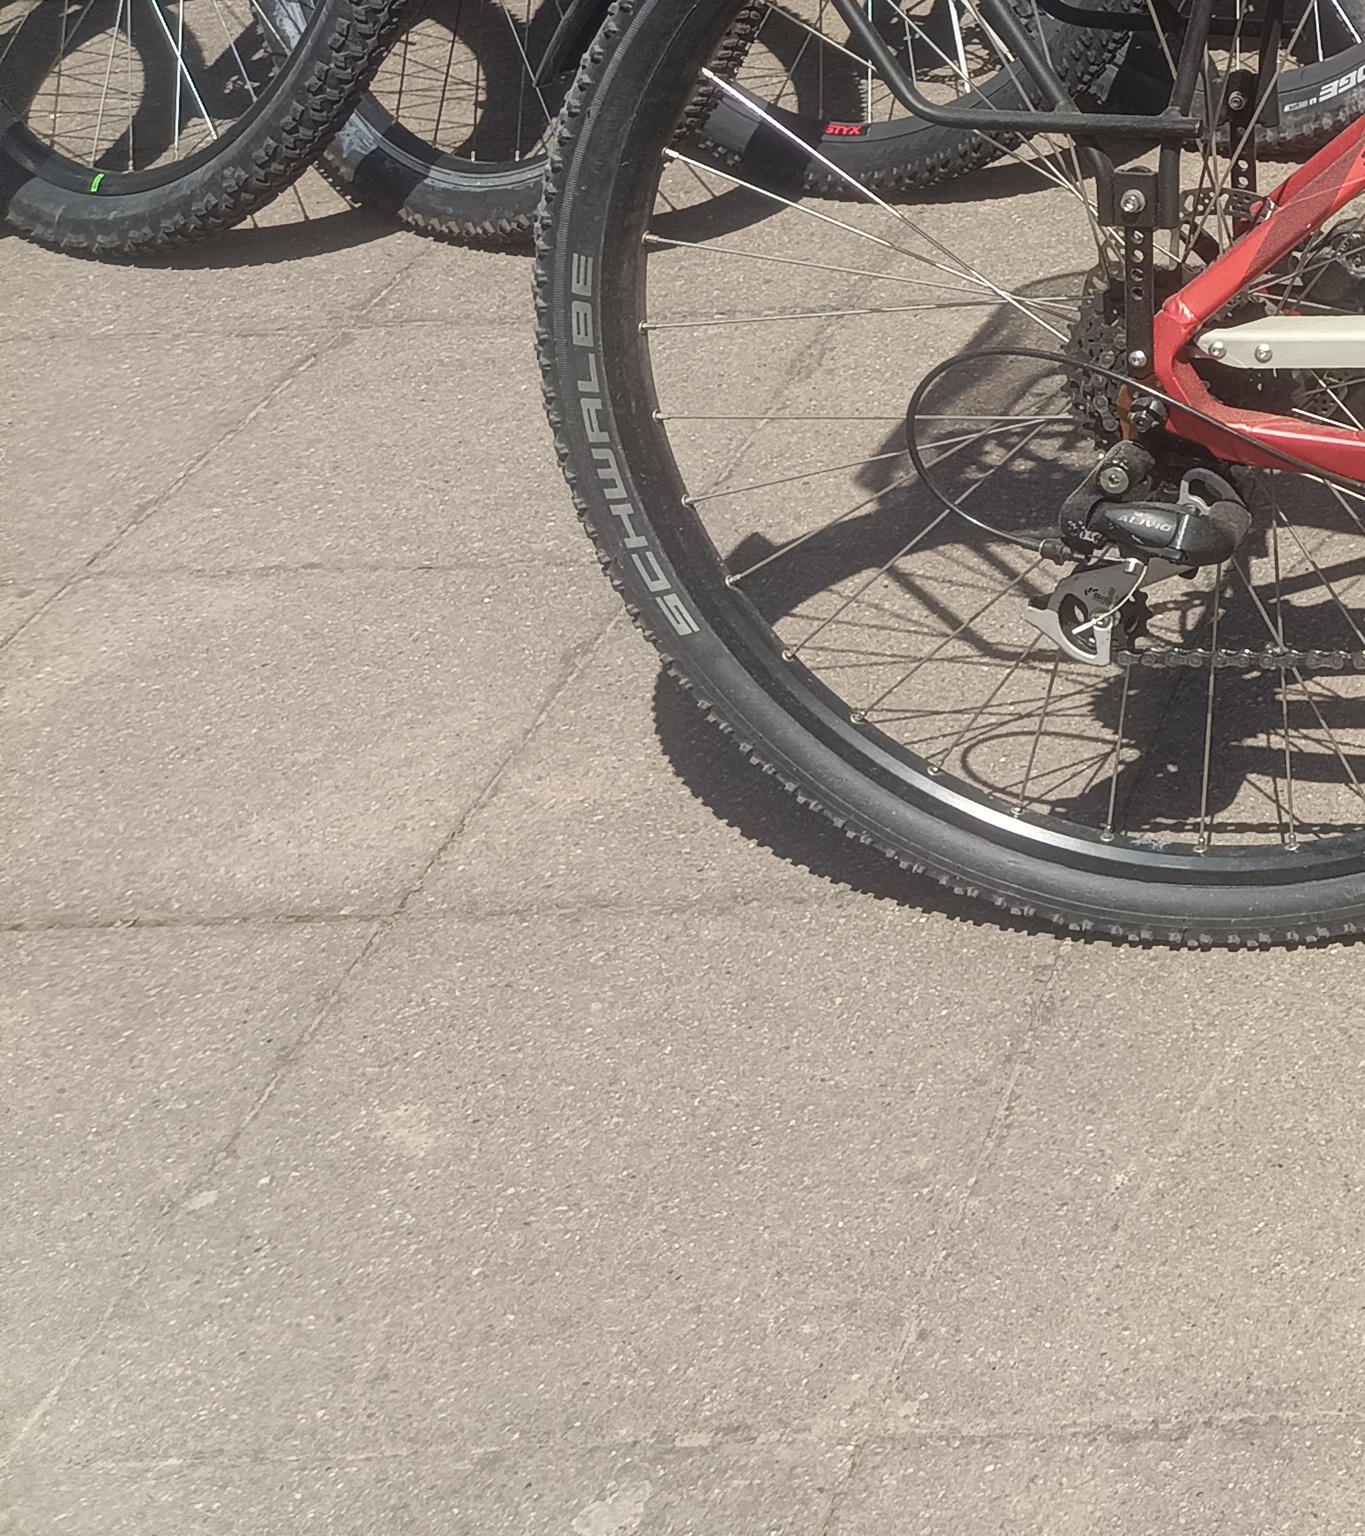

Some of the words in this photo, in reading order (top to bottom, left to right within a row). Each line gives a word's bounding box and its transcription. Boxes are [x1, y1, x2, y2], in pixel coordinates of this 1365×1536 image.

[824, 123, 862, 136] STYX
[571, 252, 699, 636] SCHWALBE
[1117, 513, 1173, 532] ALIVIO
